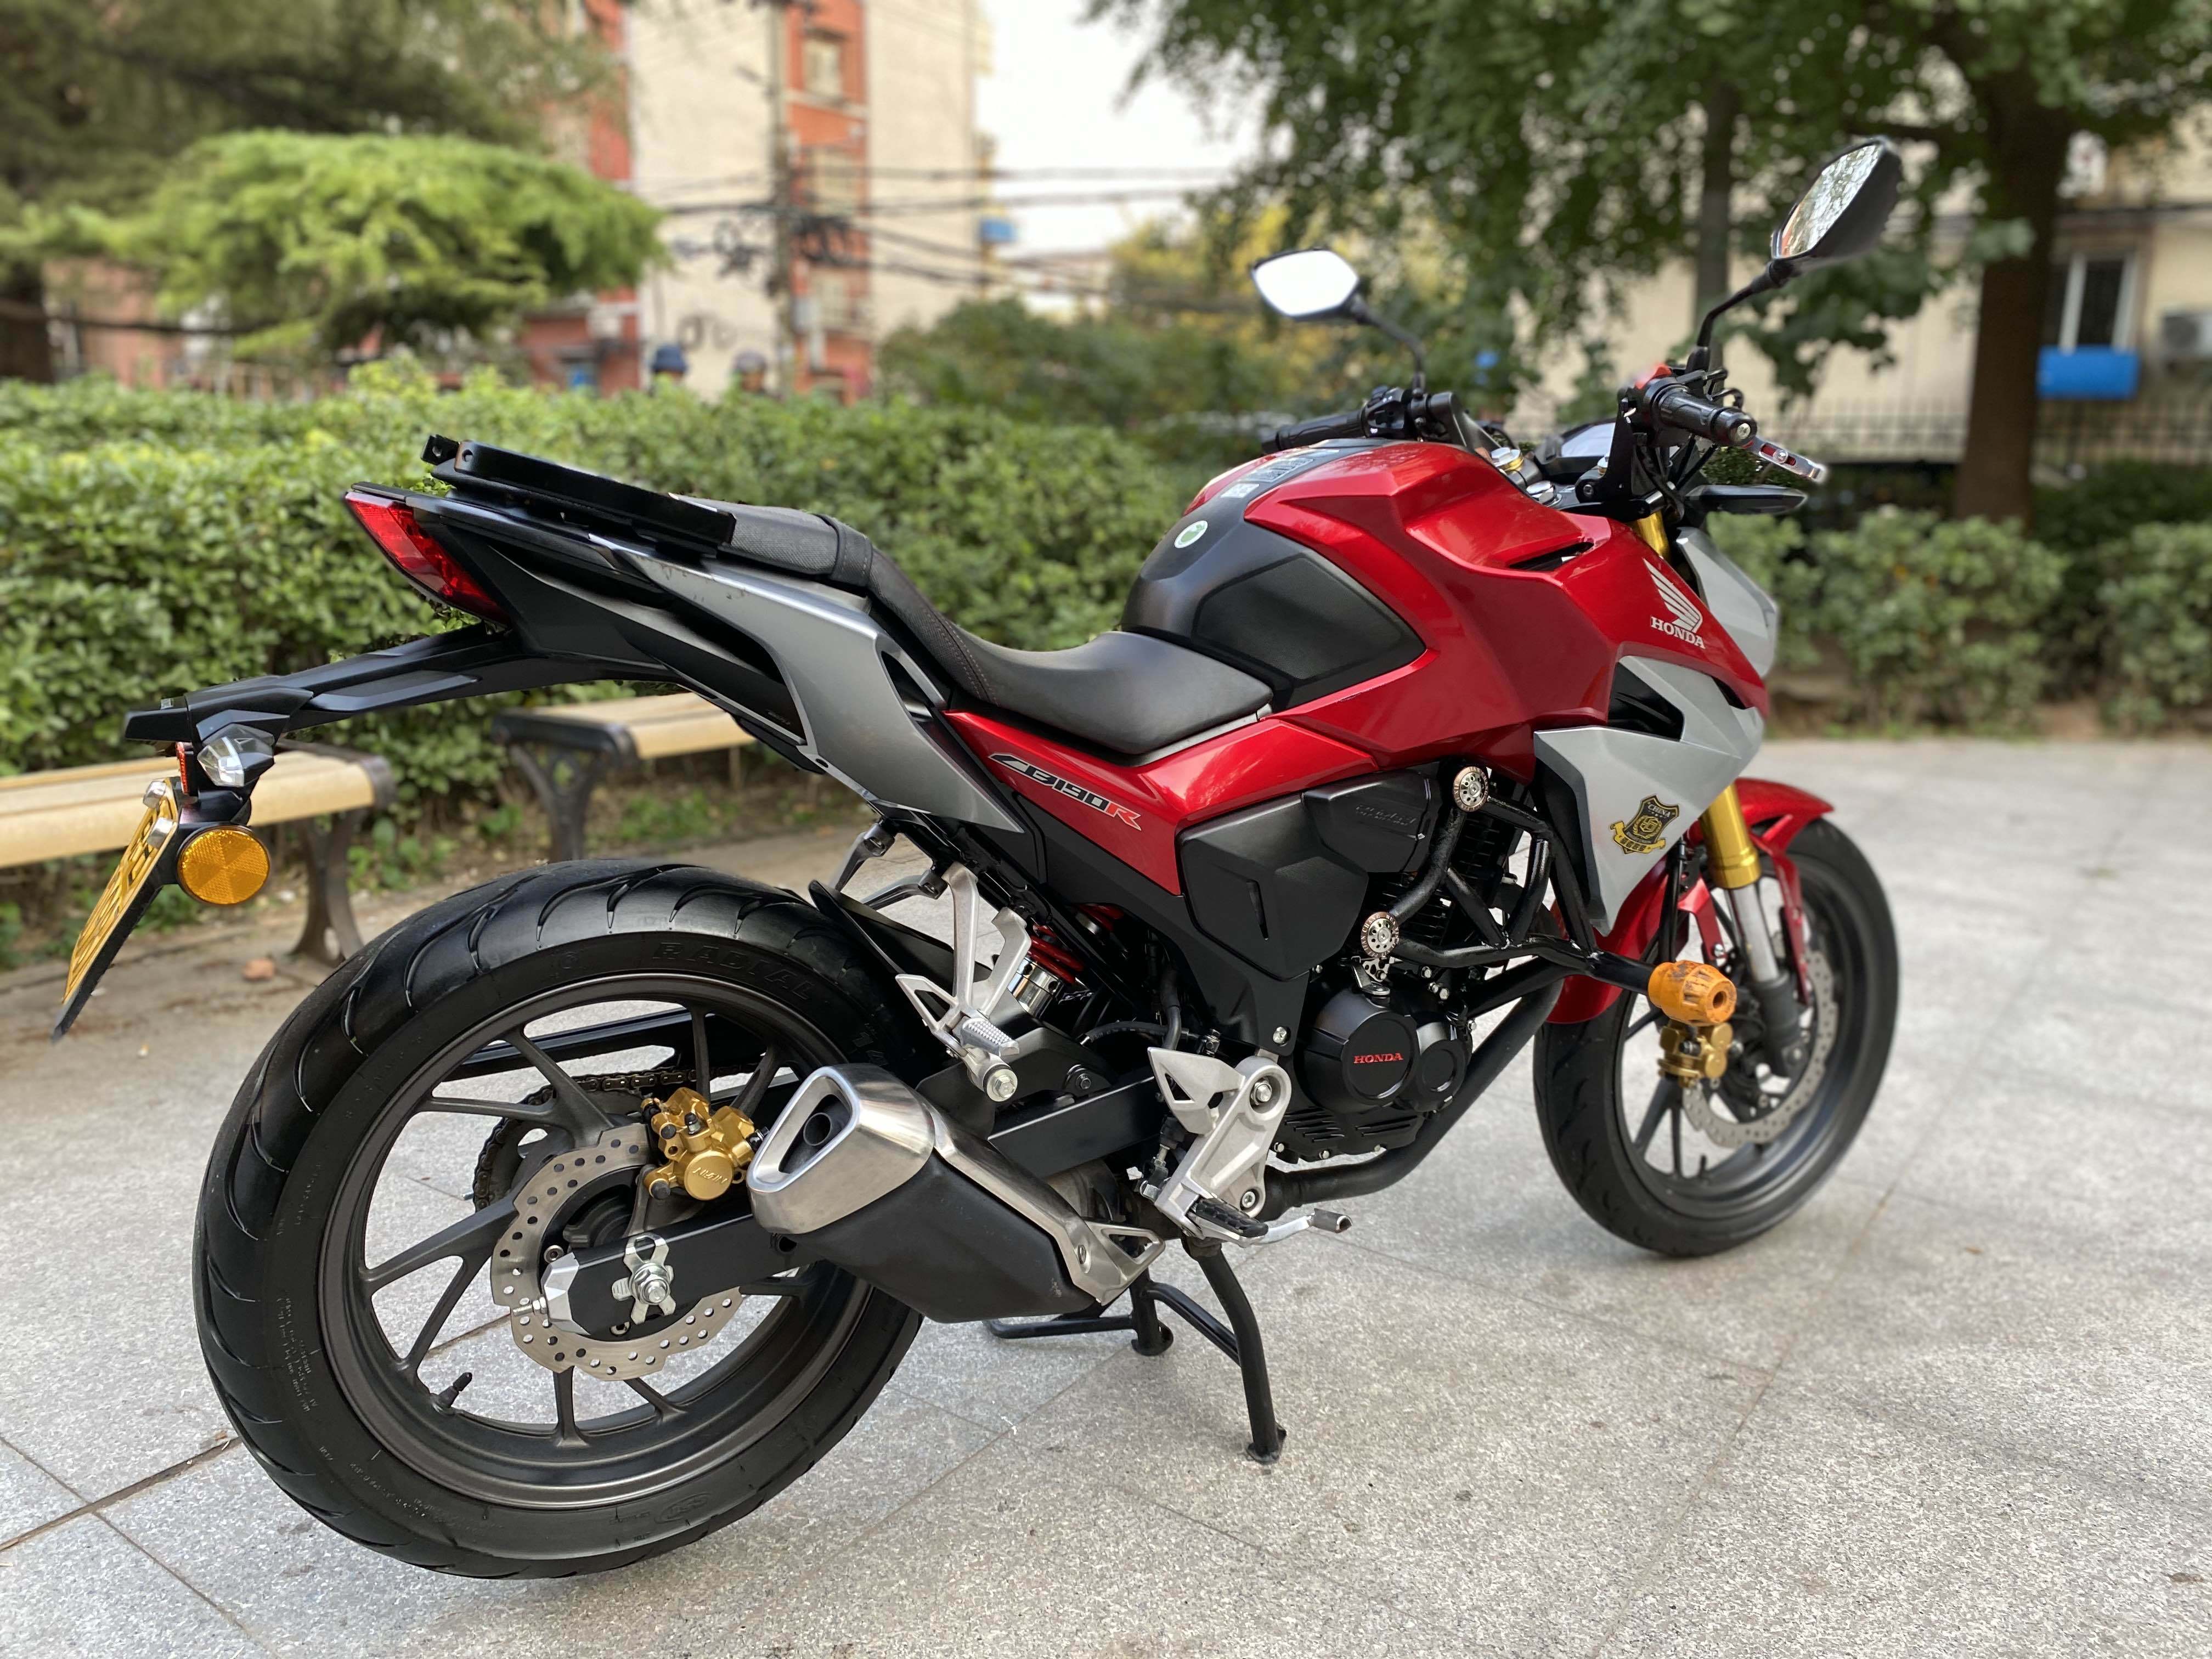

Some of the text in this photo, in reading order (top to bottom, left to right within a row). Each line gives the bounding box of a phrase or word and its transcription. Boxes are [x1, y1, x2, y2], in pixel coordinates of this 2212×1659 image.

[1650, 616, 1706, 649] HONDA
[988, 753, 1142, 831] CB190R
[1353, 1053, 1404, 1064] HONDA
[692, 1166, 728, 1184] NISSIN
